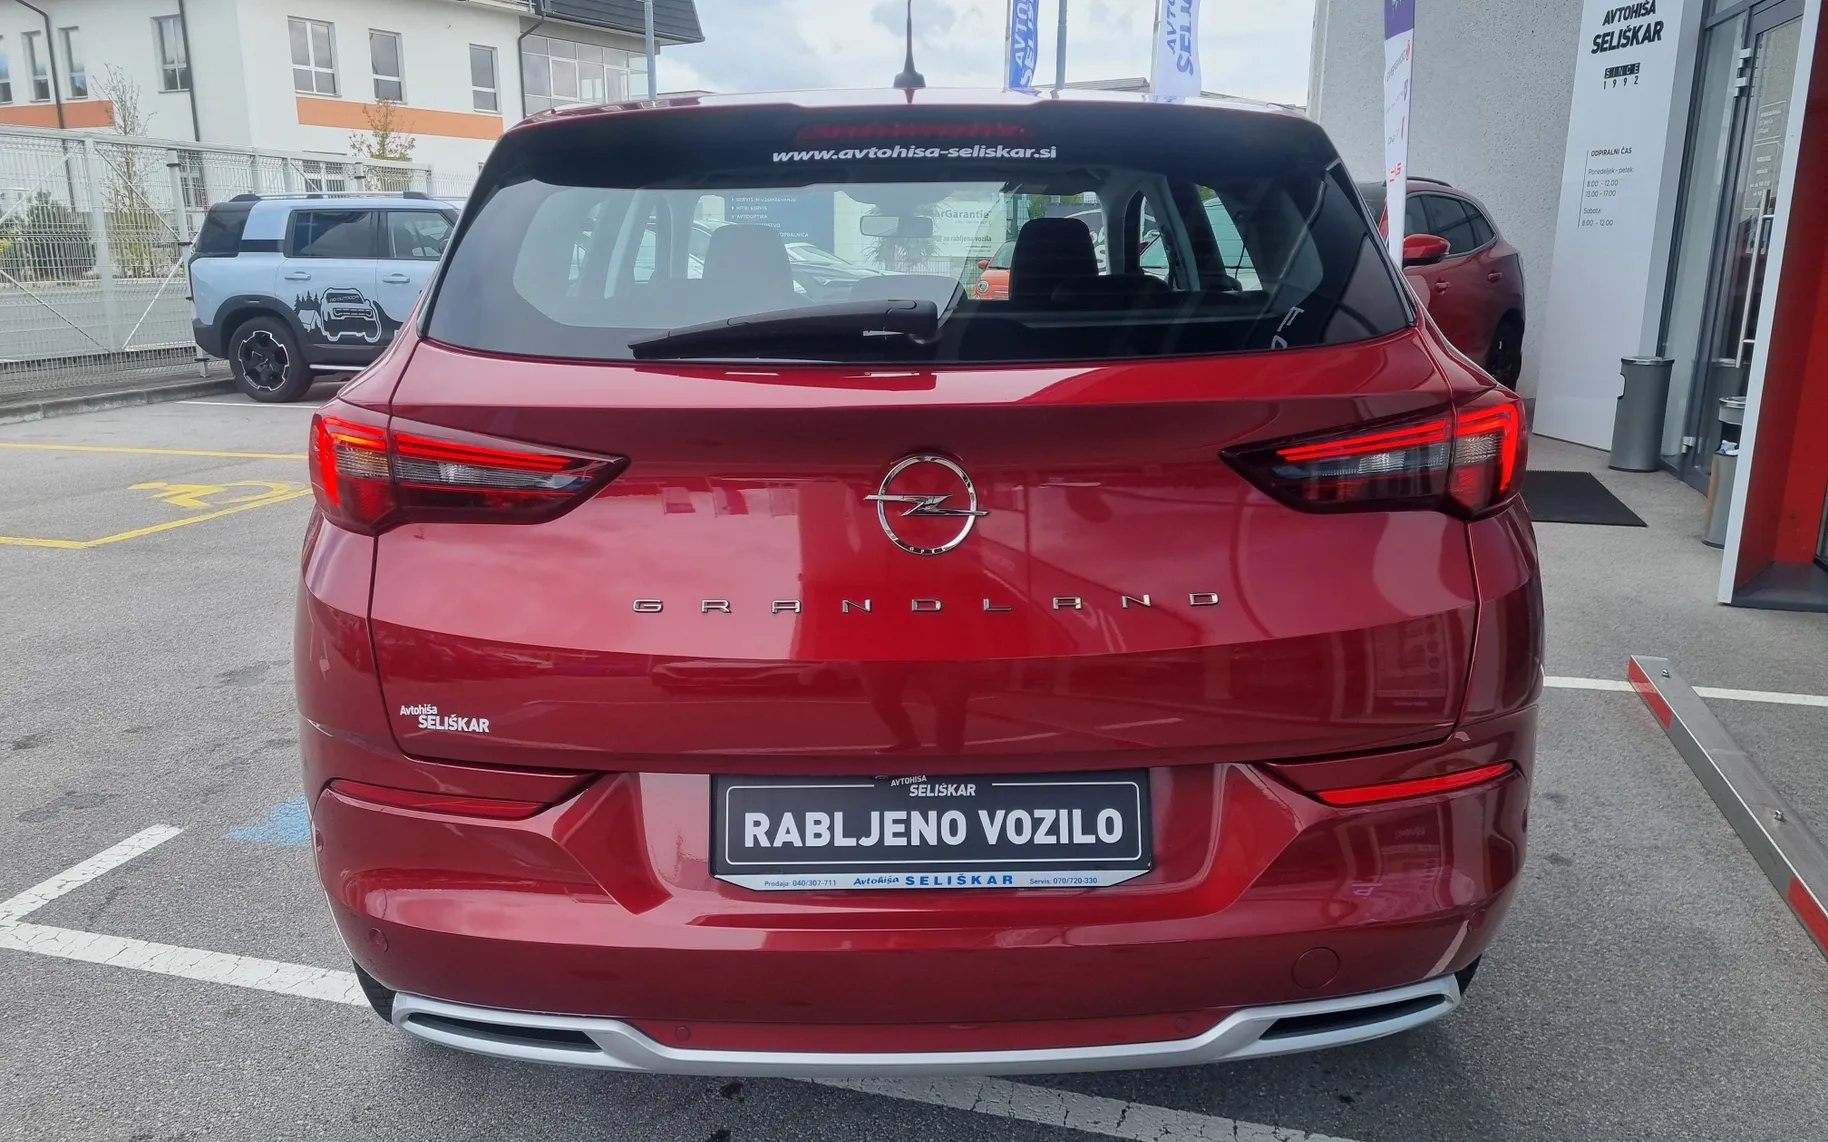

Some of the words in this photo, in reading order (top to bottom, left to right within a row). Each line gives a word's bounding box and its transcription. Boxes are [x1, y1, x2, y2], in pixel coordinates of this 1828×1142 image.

[1602, 0, 1656, 26] AVTOHIŠA
[1591, 20, 1665, 54] SELIŠKAR
[1605, 63, 1640, 78] SINCE
[772, 144, 1057, 163] www.avtohisa-seliskar.si
[1590, 148, 1620, 157] ODPIRALNI
[1620, 146, 1632, 155] ČAS
[400, 703, 438, 716] Avtohiša
[418, 713, 490, 733] SELIŠKAR
[909, 783, 976, 797] SELIŠKAR
[744, 810, 967, 848] RABLJENO
[979, 808, 1123, 846] VOZILO
[764, 879, 791, 888] Prodaja:
[792, 878, 838, 888] 040/307-711
[904, 873, 1014, 887] SELIŠKAR
[1029, 877, 1052, 886] Servis:
[1052, 877, 1099, 886] 070/720-330
